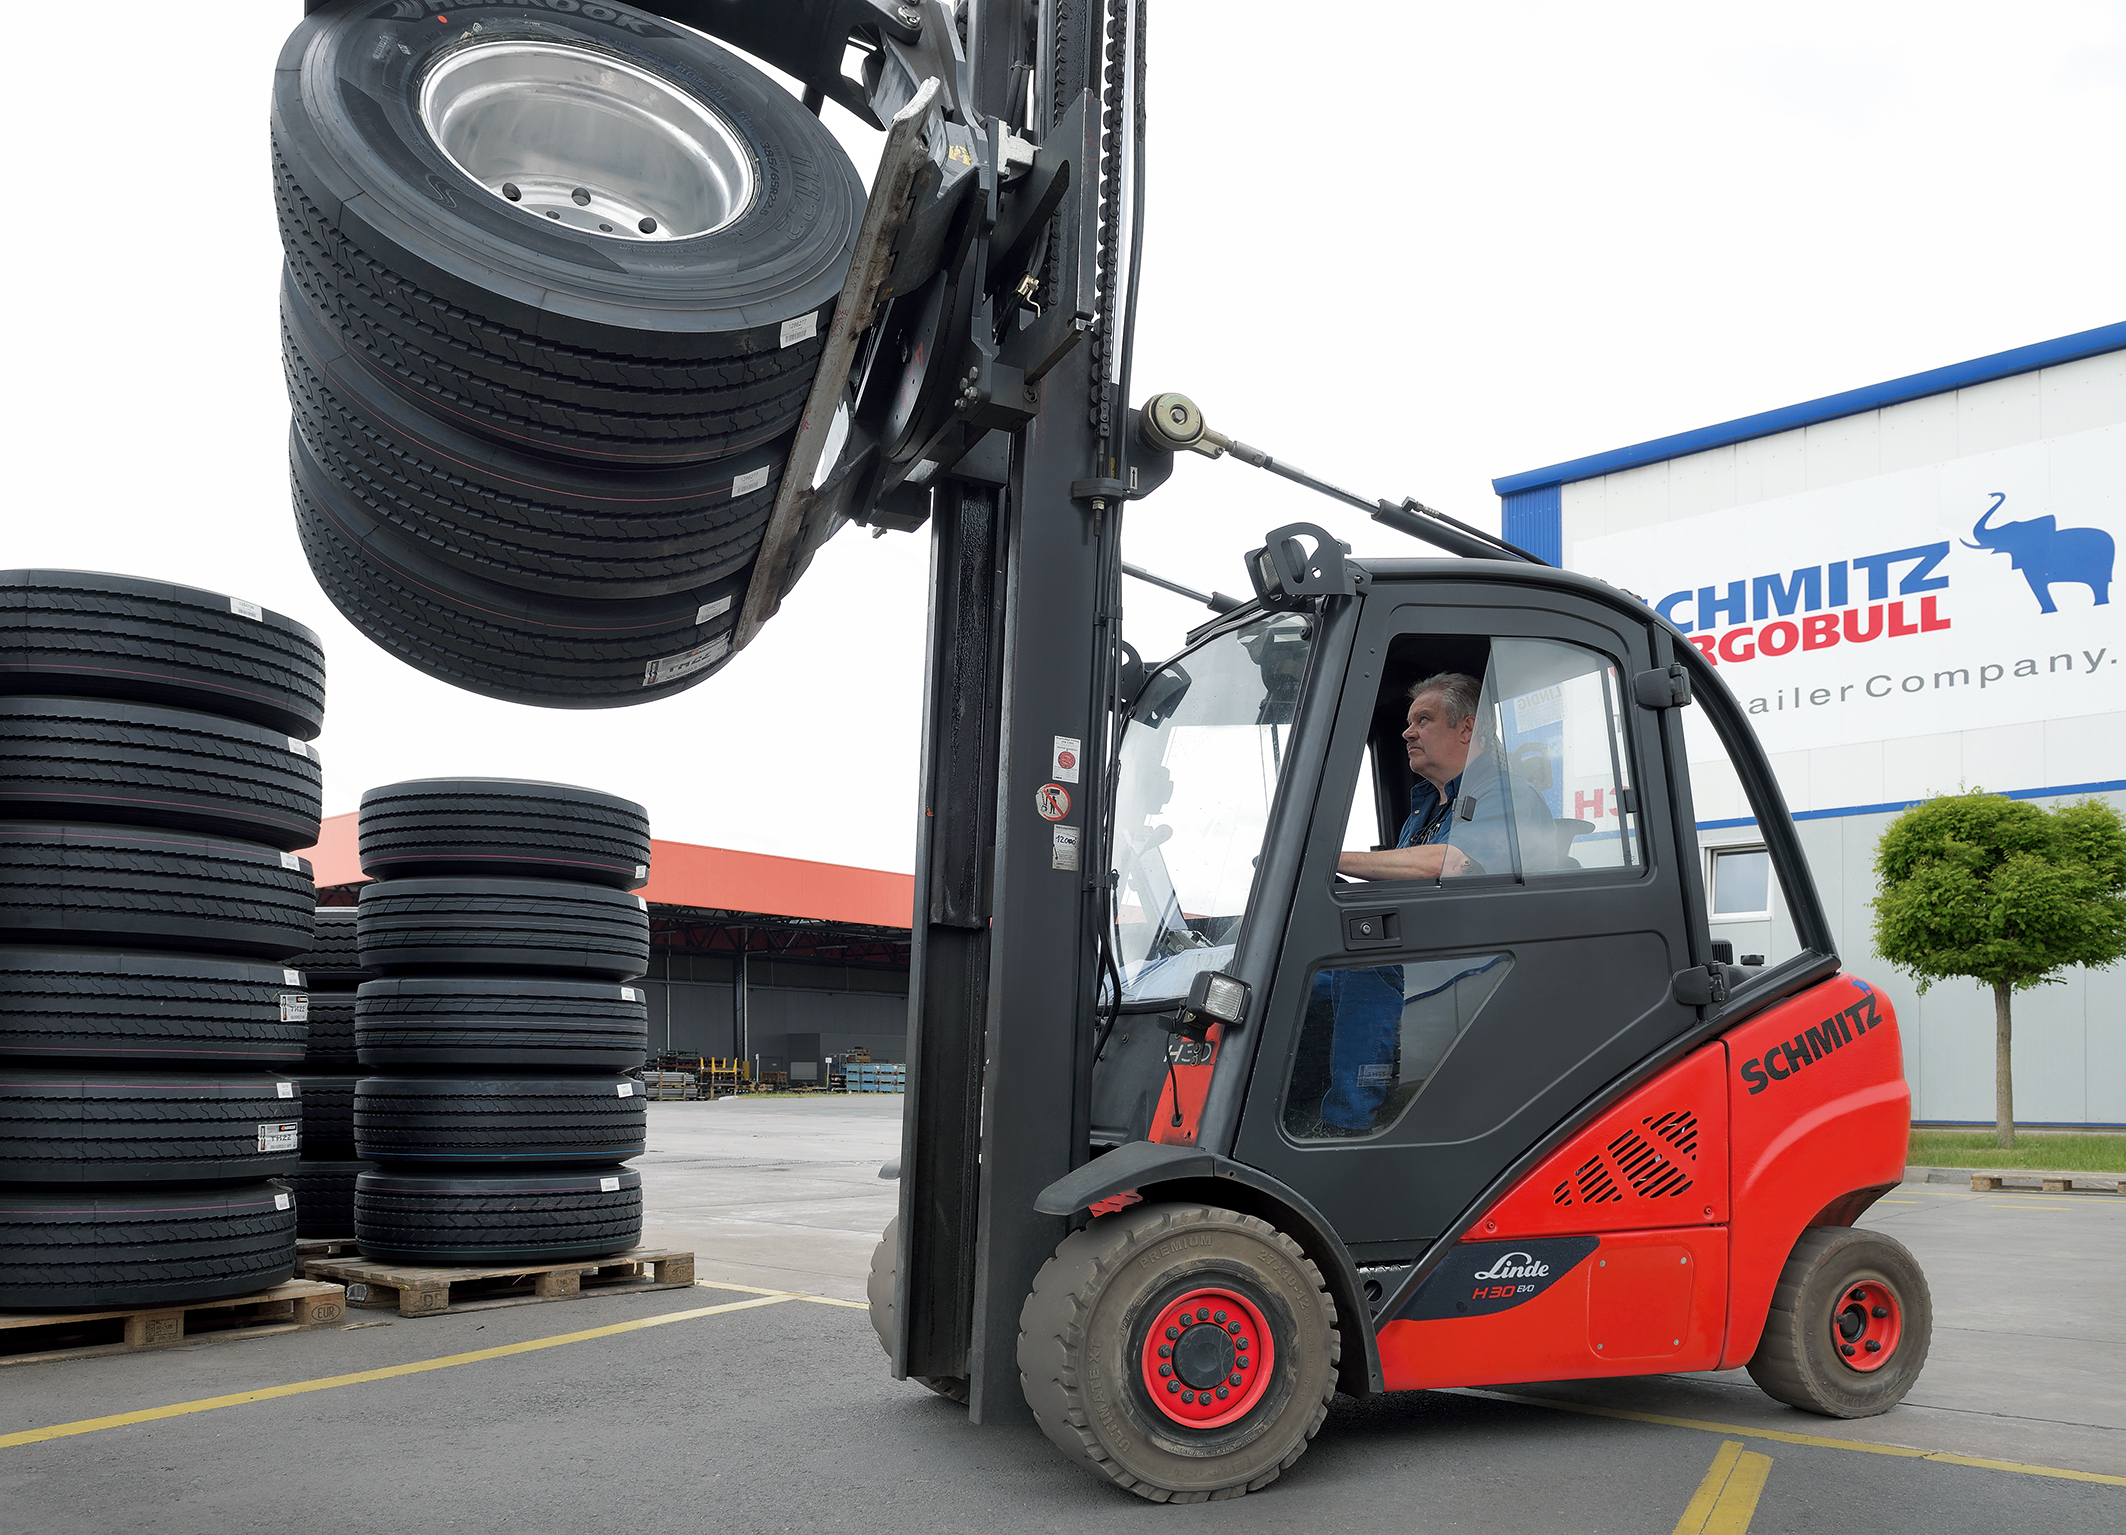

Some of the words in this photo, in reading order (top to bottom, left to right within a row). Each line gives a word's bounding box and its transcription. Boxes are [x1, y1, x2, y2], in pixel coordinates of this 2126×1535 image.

[1642, 540, 1950, 633] CHMITZ
[1688, 595, 1952, 666] RGOBULL
[1740, 993, 1884, 1096] SCHMITZ
[1138, 1234, 1212, 1270] PREMIUM
[1474, 1251, 1550, 1280] Linde
[1516, 1284, 1535, 1293] EVO
[317, 1306, 335, 1318] EUR
[1088, 1338, 1102, 1364] XT
[1087, 1368, 1132, 1454] ULTIMATE
